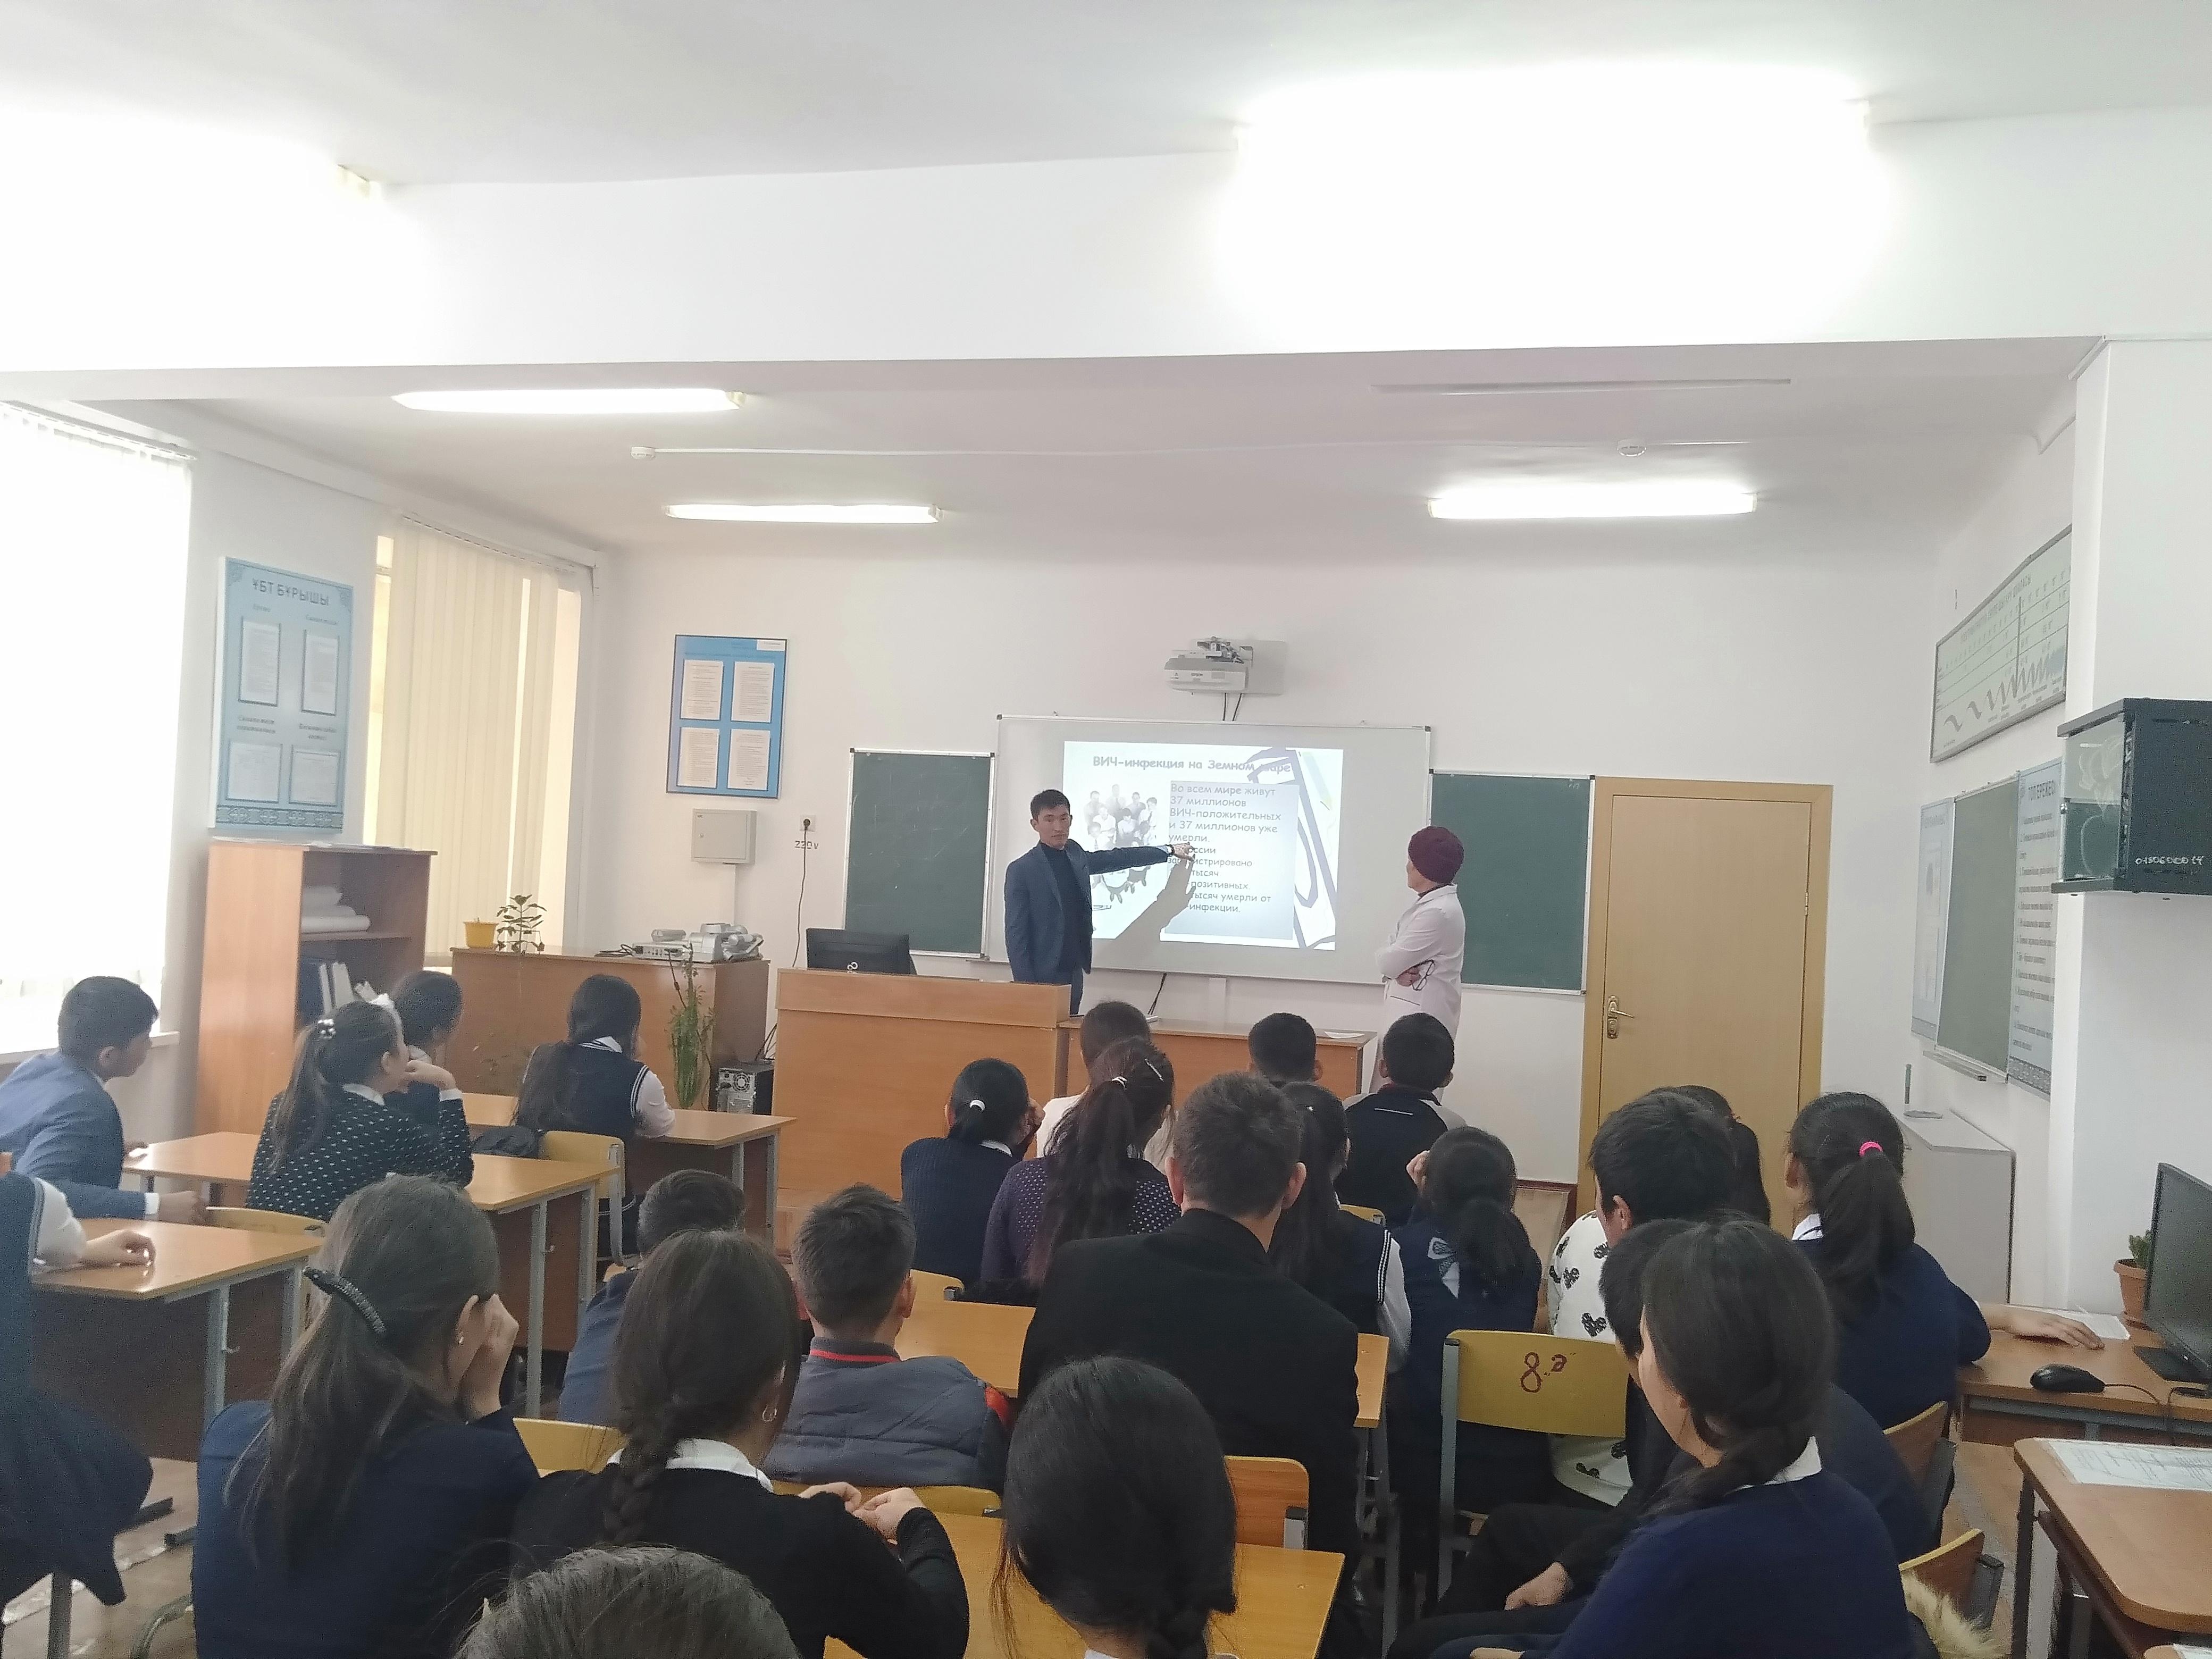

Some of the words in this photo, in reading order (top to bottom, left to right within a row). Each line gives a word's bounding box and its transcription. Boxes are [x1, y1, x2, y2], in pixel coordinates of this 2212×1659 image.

[1093, 756, 1184, 770] ВИЧ-инфекция
[1208, 760, 1255, 770] Земном
[1171, 783, 1184, 792] Во
[1214, 787, 1242, 796] мире
[1244, 787, 1276, 798] живут
[1170, 795, 1184, 804] 37
[1186, 798, 1246, 807] миллионов
[1170, 807, 1281, 820] ВИЧ-положительных
[1179, 820, 1192, 829] 37
[1195, 823, 1255, 832] миллионов
[1258, 825, 1278, 834] уже
[1168, 835, 1210, 843] умерли.
[1221, 894, 1257, 902] умерли
